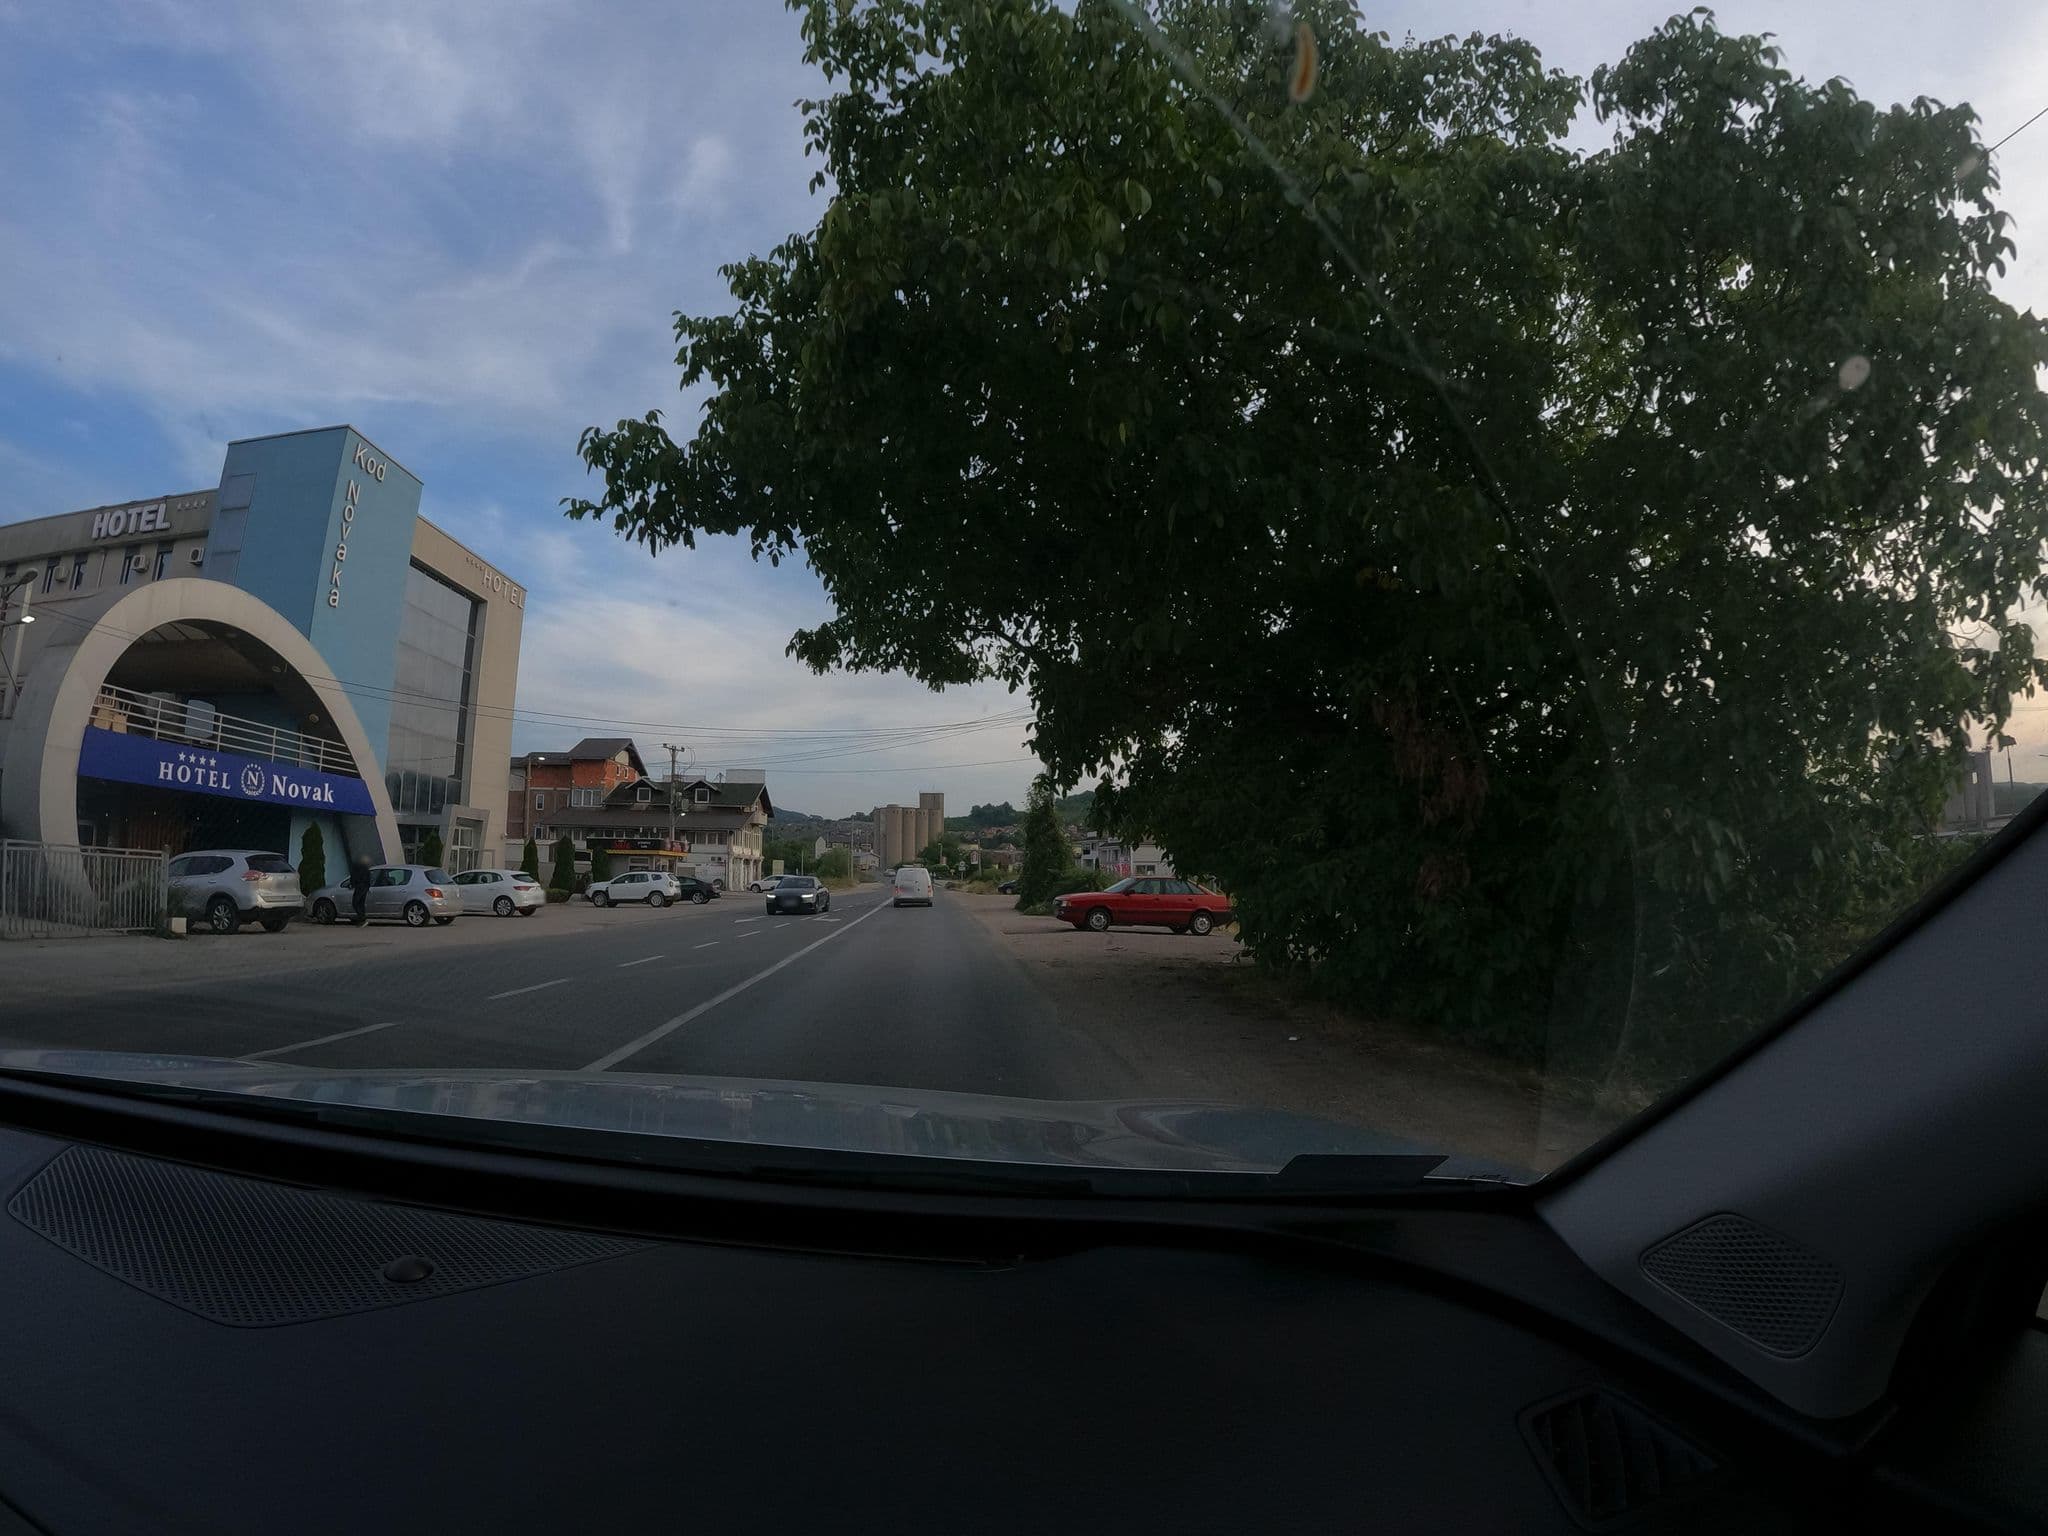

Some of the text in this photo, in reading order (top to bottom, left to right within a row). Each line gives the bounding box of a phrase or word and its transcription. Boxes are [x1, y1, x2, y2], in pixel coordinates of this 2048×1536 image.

[354, 443, 387, 481] Kod
[91, 503, 171, 539] HOTEL
[329, 480, 361, 607] Novaka
[483, 568, 524, 609] HOTEL
[158, 761, 334, 804] HOTEL N Novak
